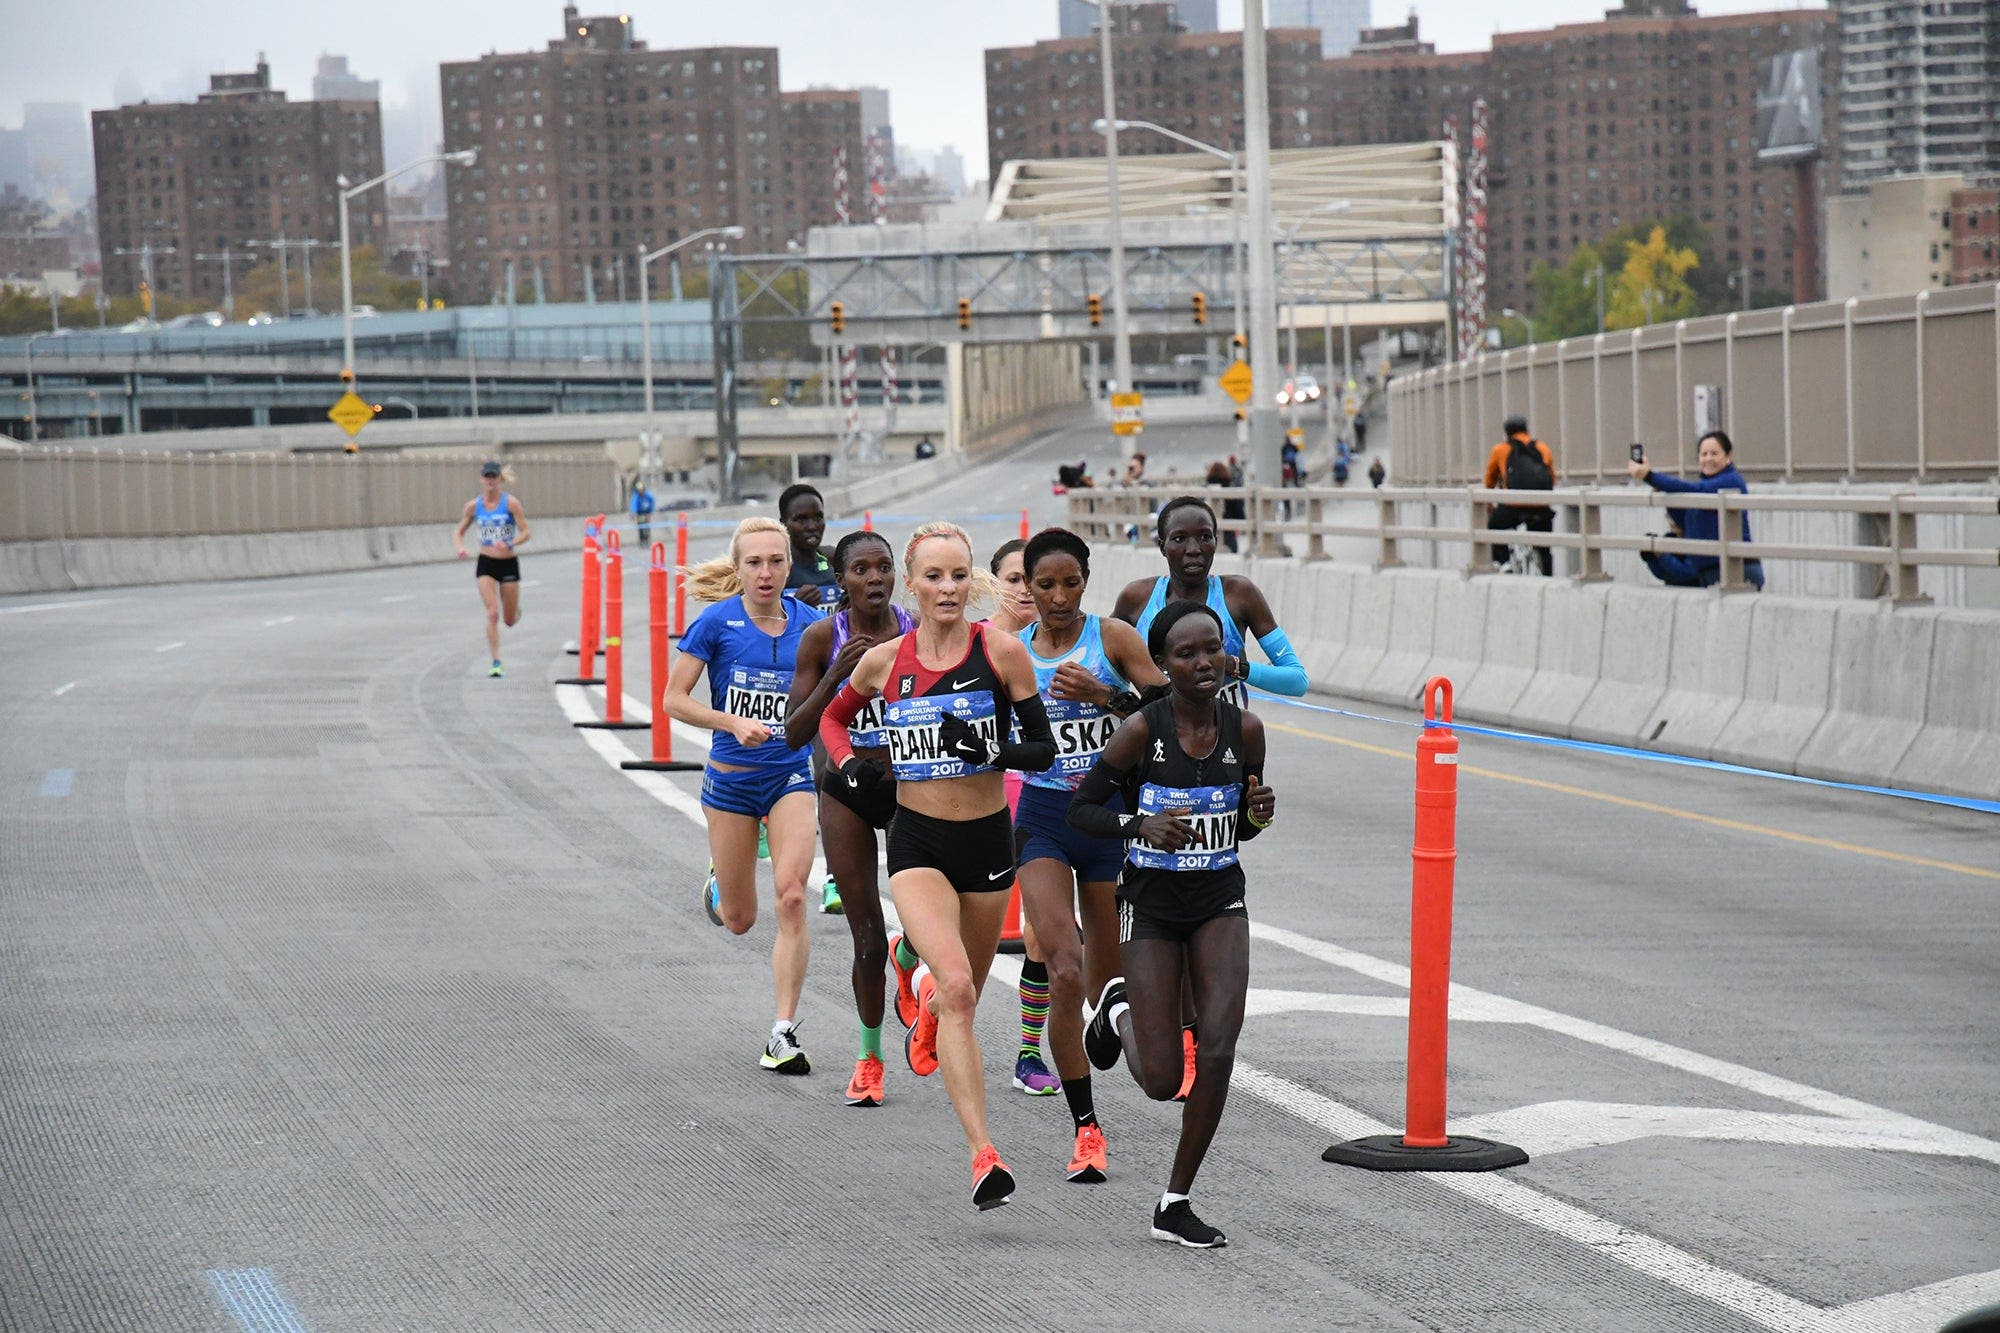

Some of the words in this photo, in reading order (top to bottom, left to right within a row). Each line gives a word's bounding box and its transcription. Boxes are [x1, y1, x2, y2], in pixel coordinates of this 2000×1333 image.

[730, 689, 788, 723] VRABC
[901, 705, 943, 716] CONSULTANCY
[907, 714, 936, 722] SERVICES
[952, 709, 972, 717] TATA
[1056, 716, 1115, 754] SKA
[1062, 757, 1091, 769] 2017
[931, 763, 964, 776] 2017
[1170, 791, 1190, 799] TATA
[1156, 796, 1202, 806] CONSULTANCY
[1177, 856, 1211, 867] 2017
